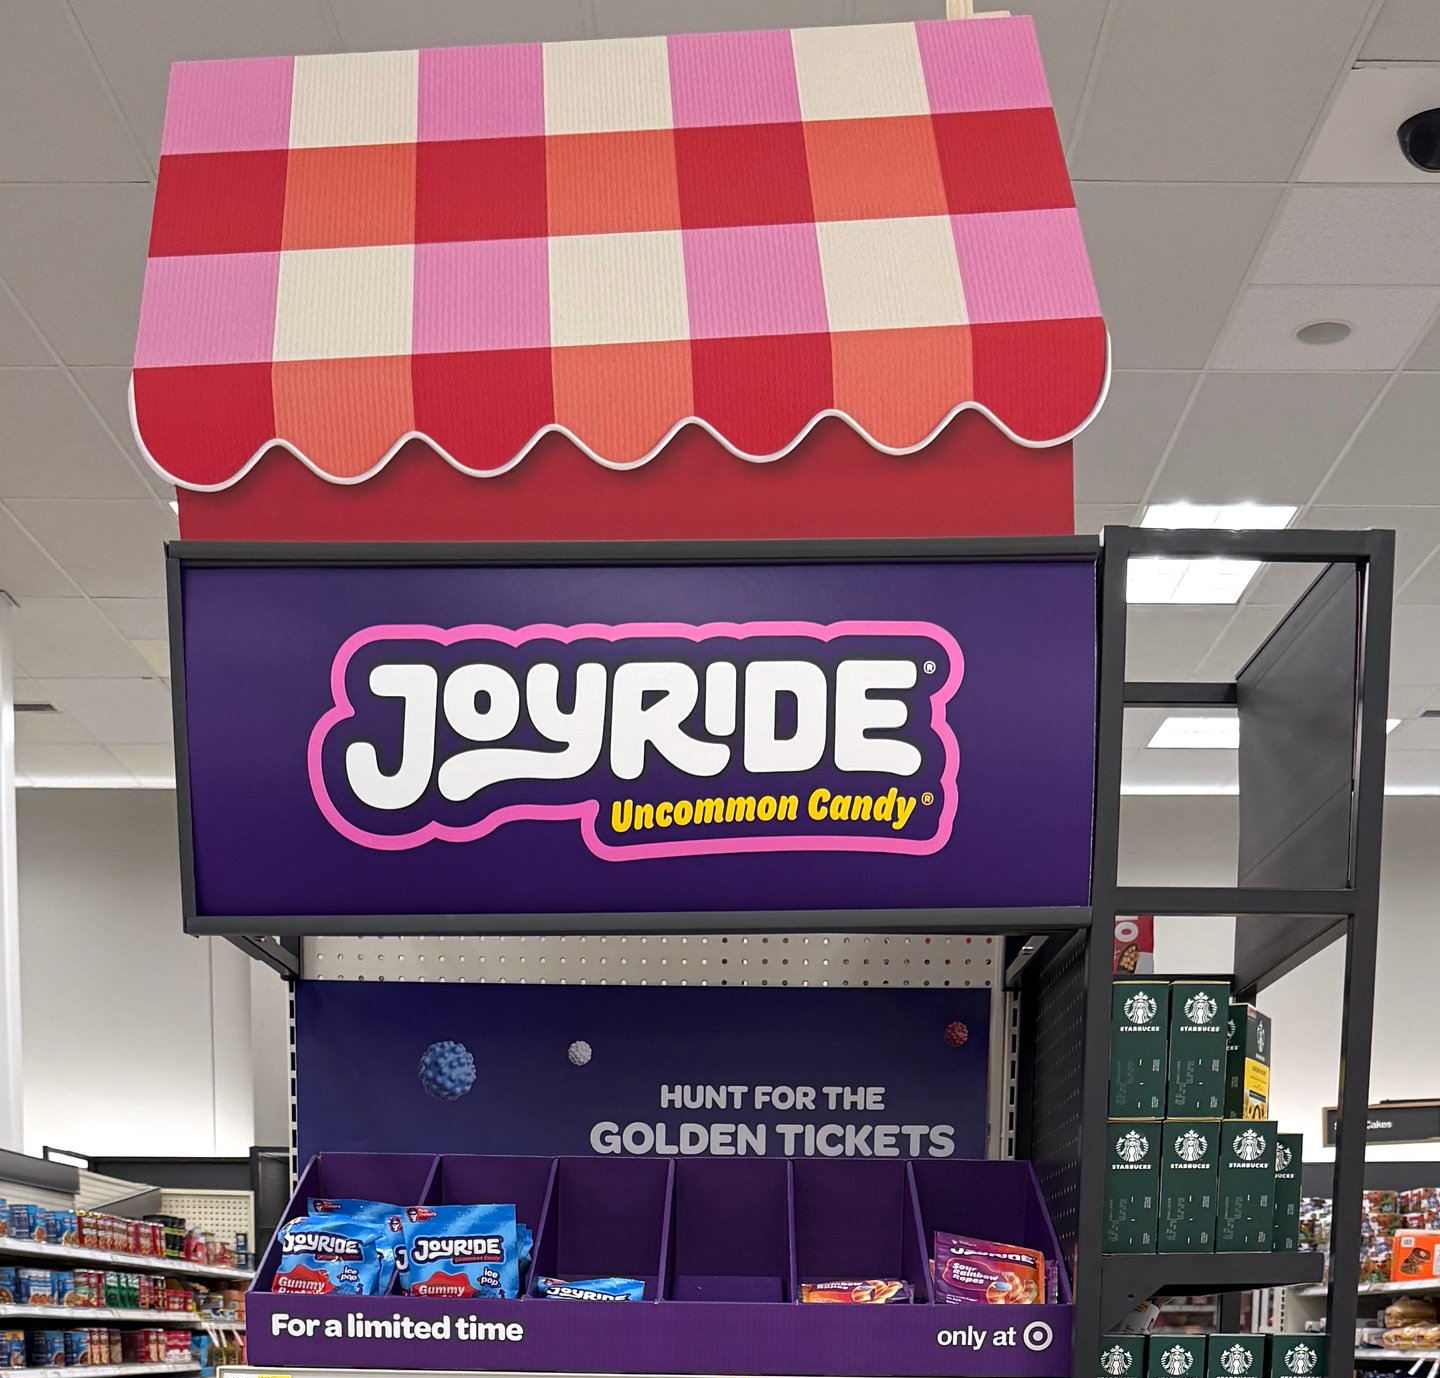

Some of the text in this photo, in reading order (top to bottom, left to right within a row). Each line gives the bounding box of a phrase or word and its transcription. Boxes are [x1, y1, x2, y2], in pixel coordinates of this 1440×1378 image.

[611, 787, 918, 833] Uncommon Candy
[660, 1085, 885, 1110] HUNT FOR THE
[590, 1121, 956, 1158] GOLDEN TICKETS
[282, 1233, 359, 1253] JOYRIDE
[414, 1238, 501, 1261] JOYRIDE
[278, 1277, 325, 1291] Gummy
[418, 1285, 465, 1297] Gummy
[271, 1313, 524, 1342] For a limited time
[937, 1326, 1017, 1352] only at
